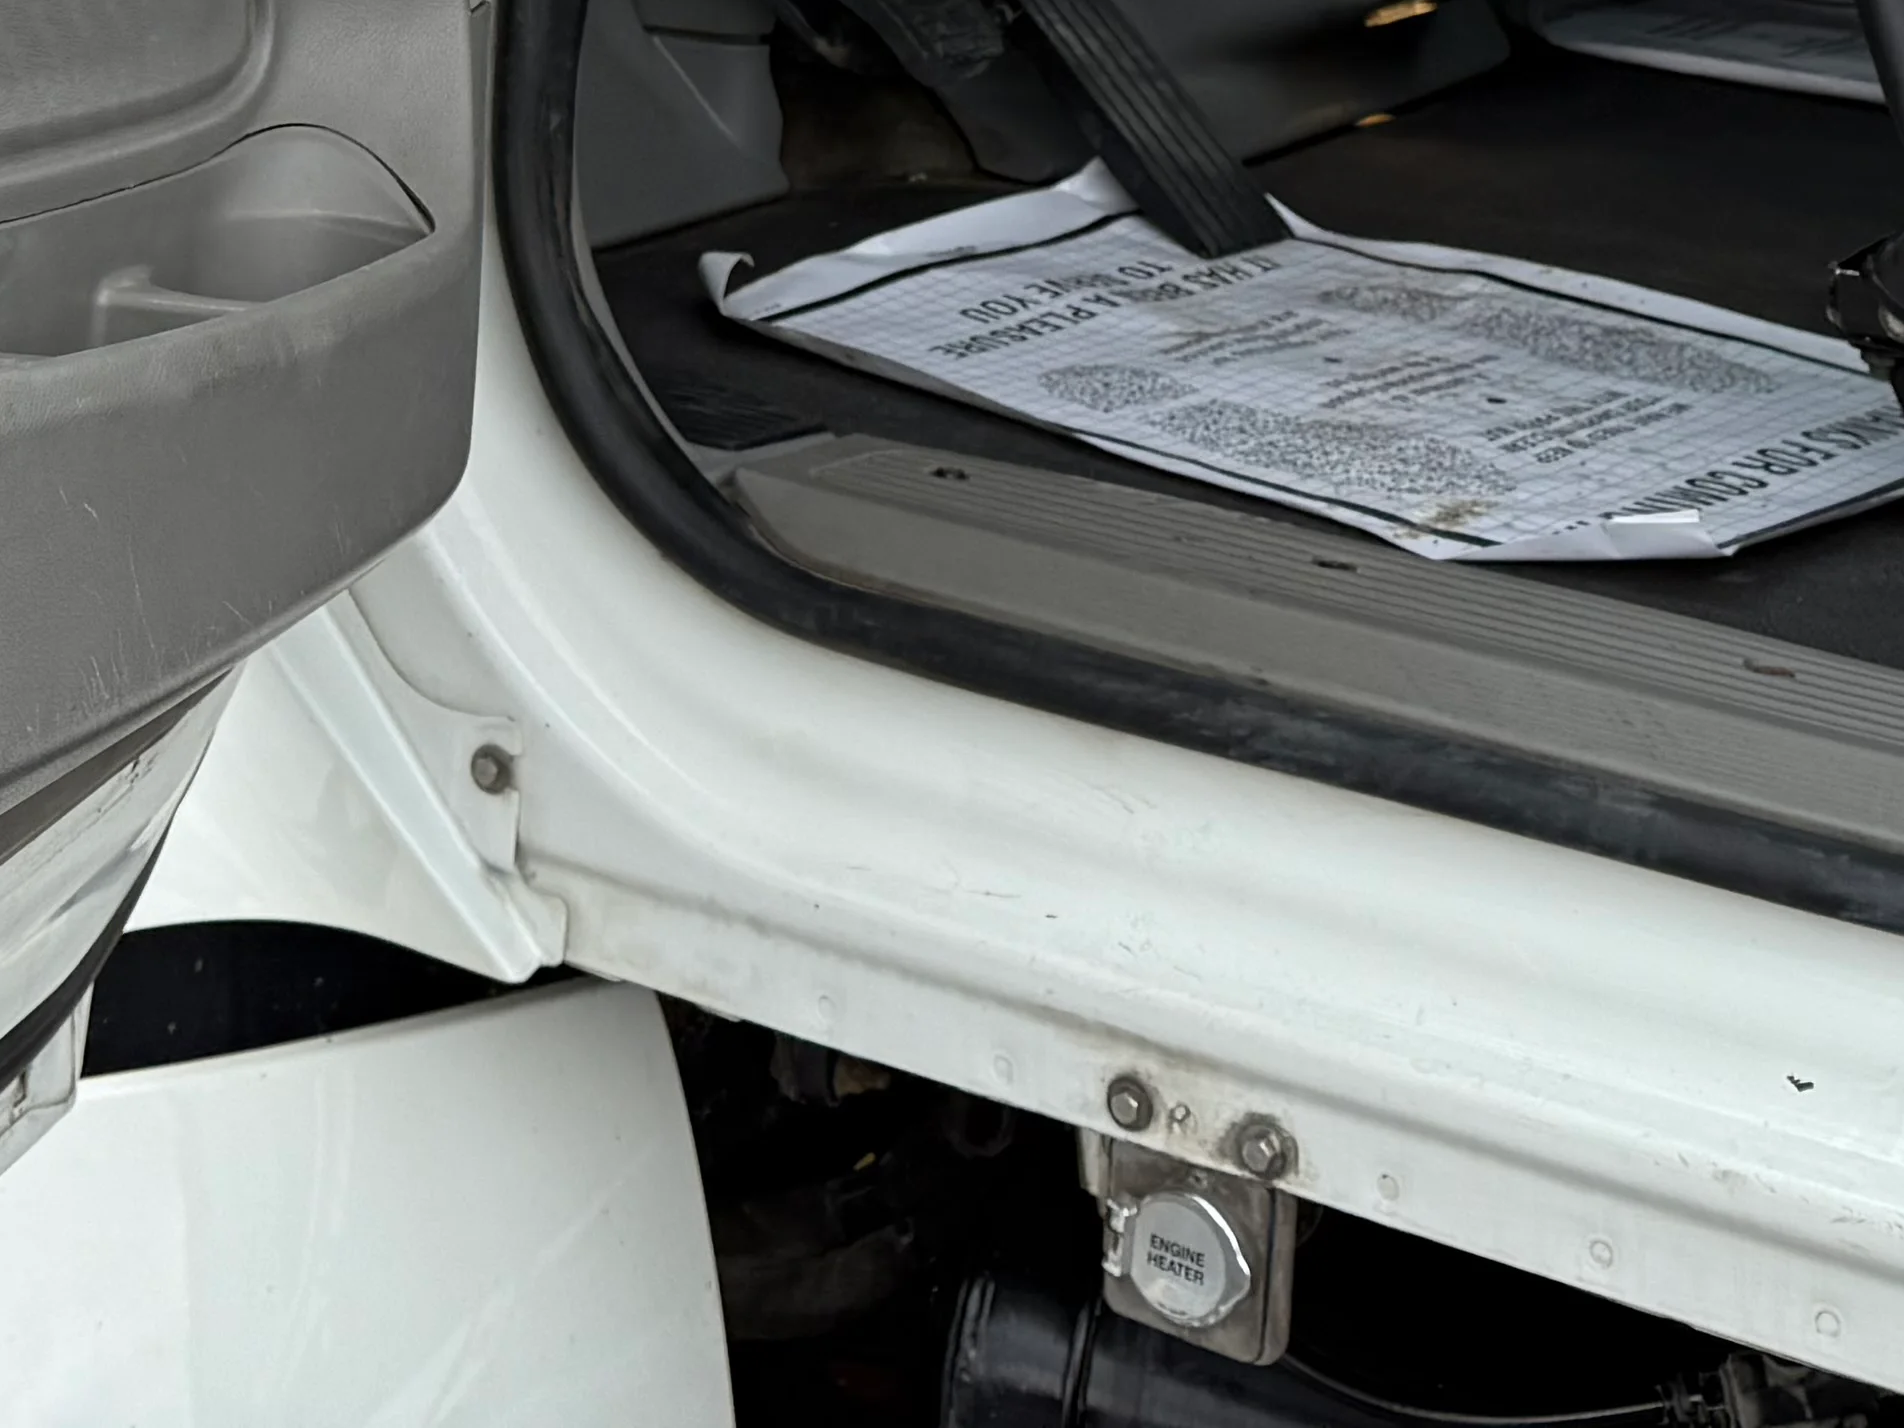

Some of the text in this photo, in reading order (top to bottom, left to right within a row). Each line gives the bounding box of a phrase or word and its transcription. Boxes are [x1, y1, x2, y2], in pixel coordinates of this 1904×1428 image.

[959, 254, 1174, 325] TO YOU
[1181, 259, 1254, 290] HAS
[1081, 292, 1123, 308] A
[928, 302, 1100, 361] PLEASURE
[1731, 438, 1840, 477] FOR
[1150, 1234, 1205, 1267] ENGINE
[1147, 1253, 1204, 1285] HEATER
